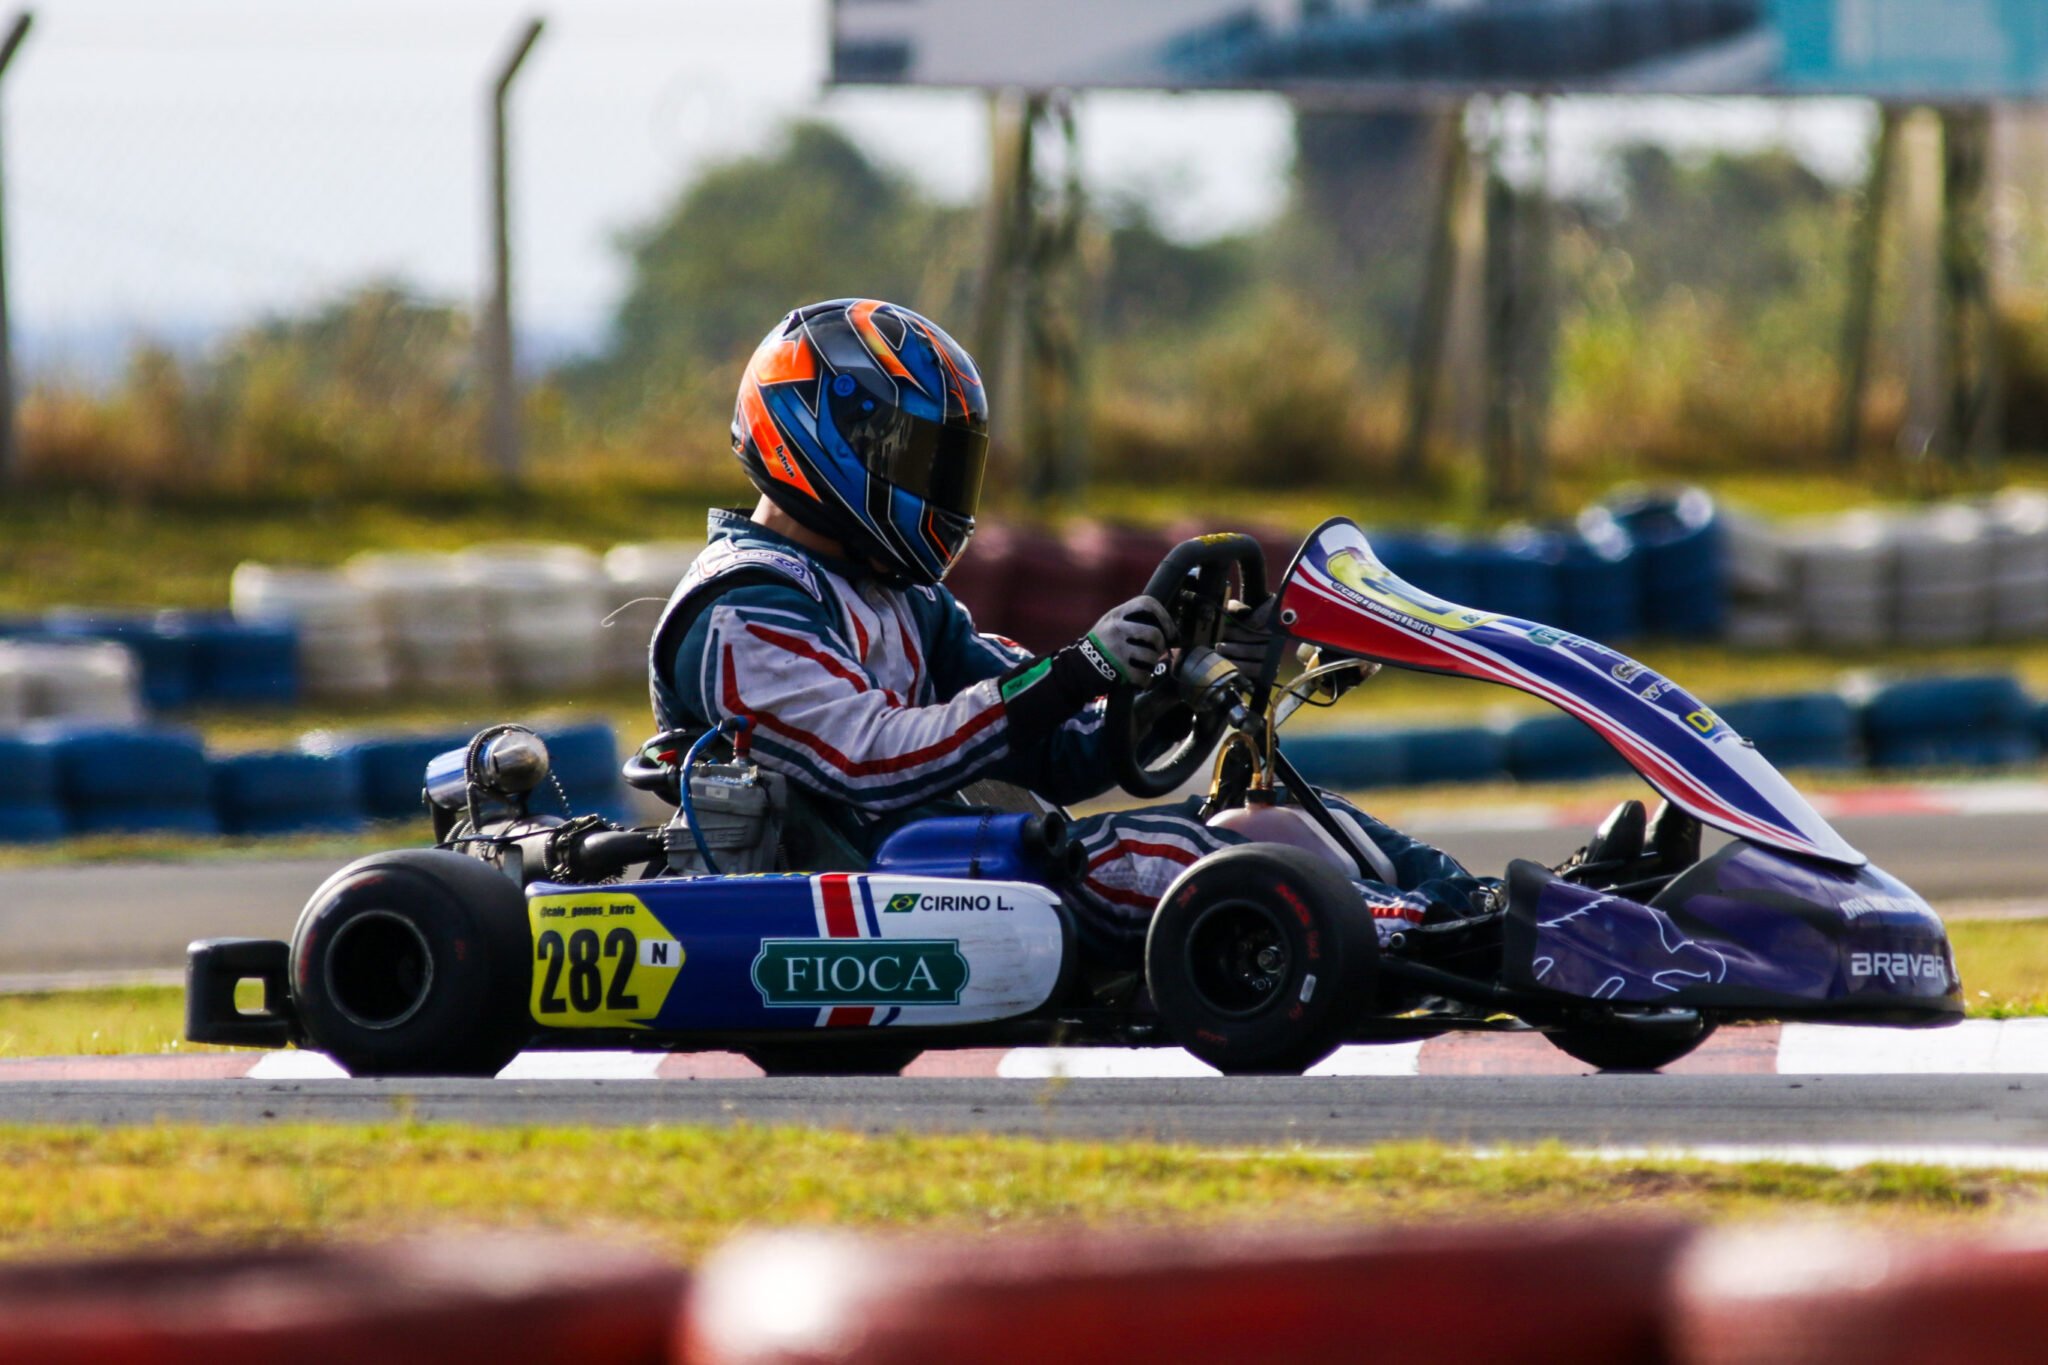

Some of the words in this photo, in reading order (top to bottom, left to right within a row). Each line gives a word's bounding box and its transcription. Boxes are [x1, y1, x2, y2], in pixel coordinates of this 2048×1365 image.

[1080, 639, 1116, 678] sparco
[920, 895, 991, 912] CIRINO
[997, 895, 1015, 911] L.
[537, 927, 639, 1014] 282
[651, 942, 668, 965] N
[783, 955, 941, 993] FIOCA
